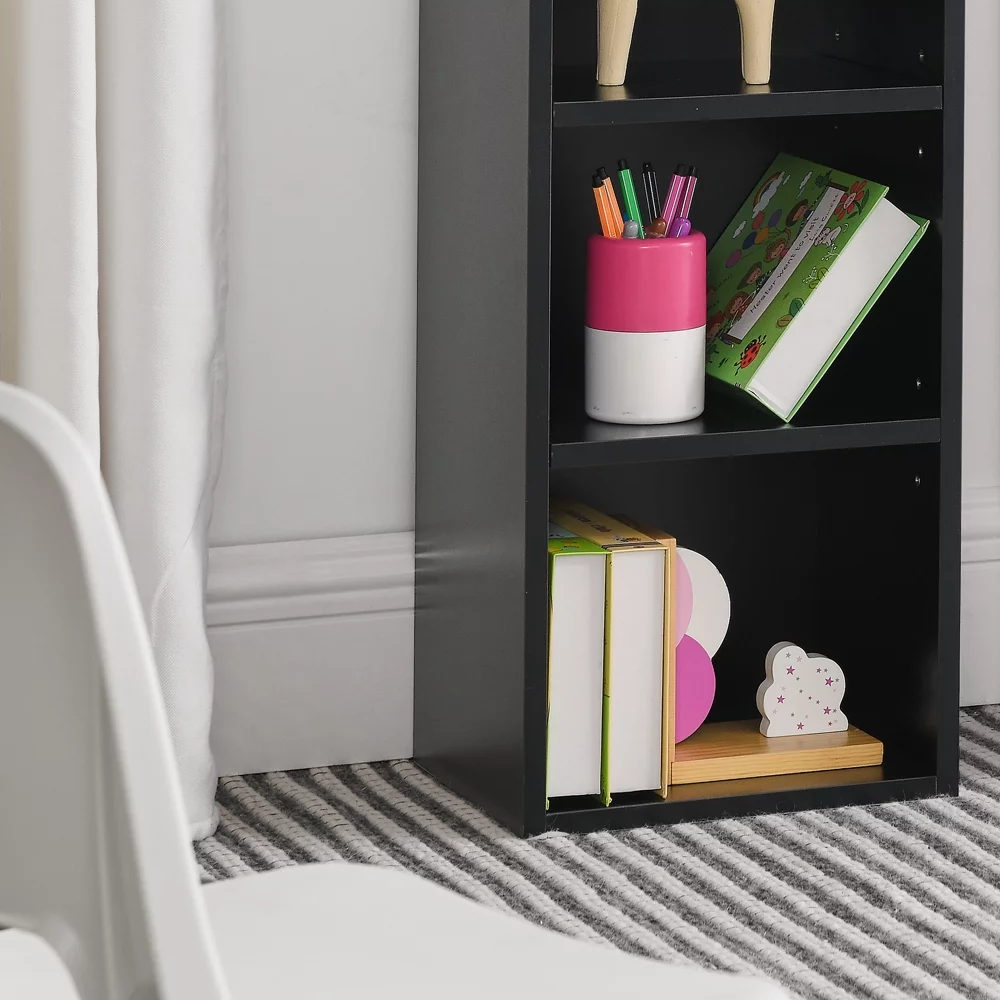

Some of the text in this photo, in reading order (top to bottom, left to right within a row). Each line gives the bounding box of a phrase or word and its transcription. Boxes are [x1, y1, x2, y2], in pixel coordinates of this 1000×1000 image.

[776, 253, 797, 279] went
[794, 240, 805, 252] to
[803, 216, 820, 239] visit
